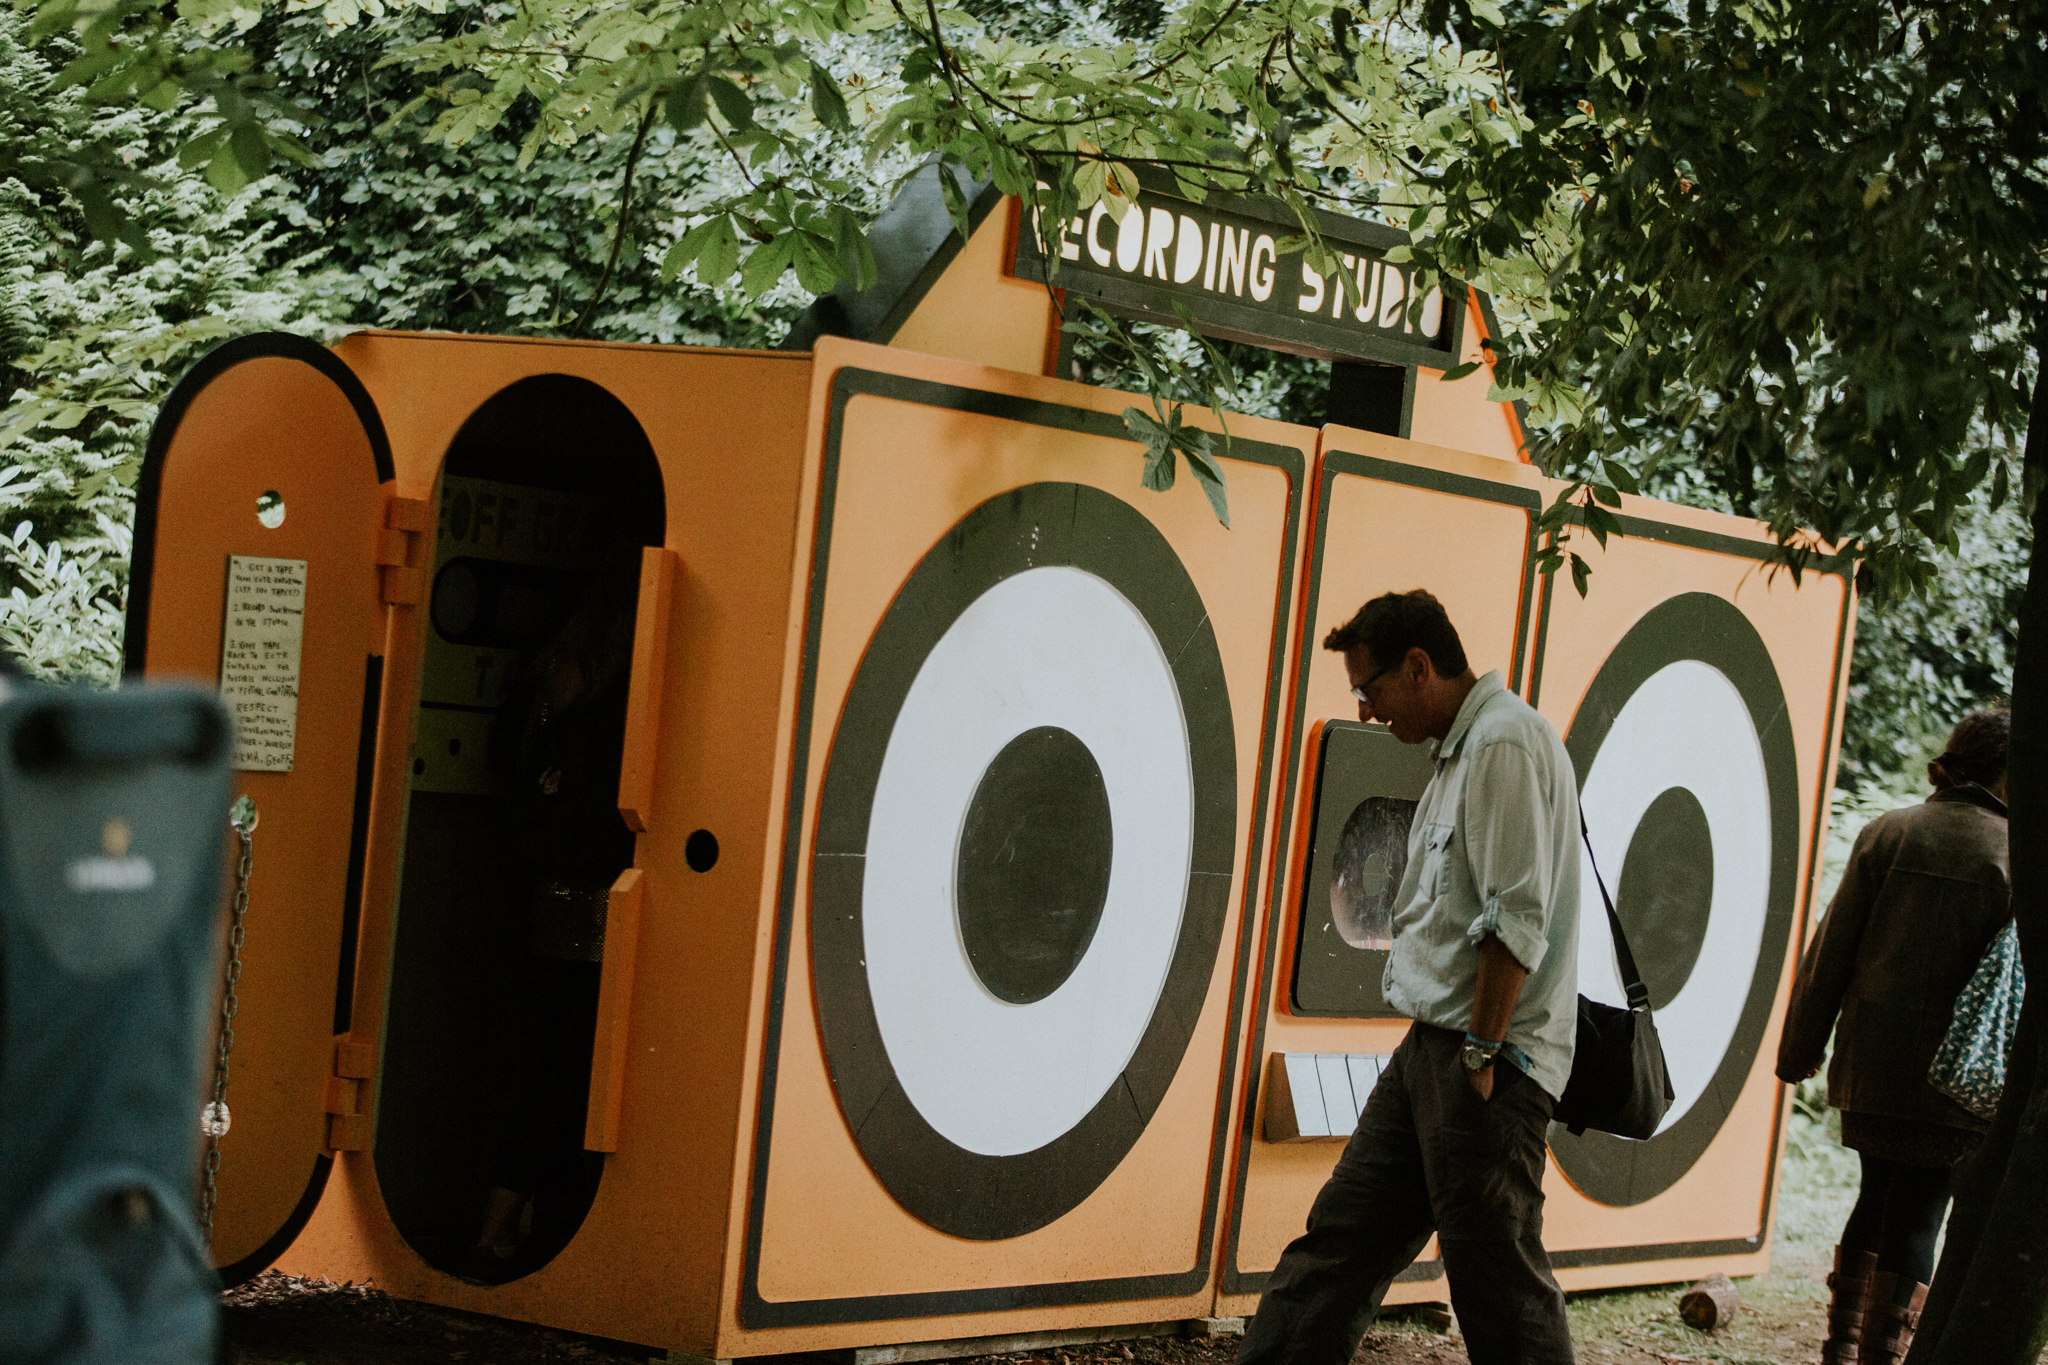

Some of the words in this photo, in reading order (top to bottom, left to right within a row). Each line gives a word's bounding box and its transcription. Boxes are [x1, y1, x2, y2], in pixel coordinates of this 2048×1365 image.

[1298, 253, 1443, 338] STUDIO
[249, 563, 265, 571] GET
[276, 565, 293, 574] TAPE
[242, 603, 265, 612] RECORD
[263, 618, 288, 627] STUDIO
[239, 641, 256, 649] GIVE
[227, 651, 246, 659] BACK
[250, 651, 258, 659] TO
[265, 651, 288, 659] EOTR
[226, 661, 266, 670] EMPORIUM
[262, 675, 296, 683] INCLUSION
[237, 702, 279, 712] RESPECT
